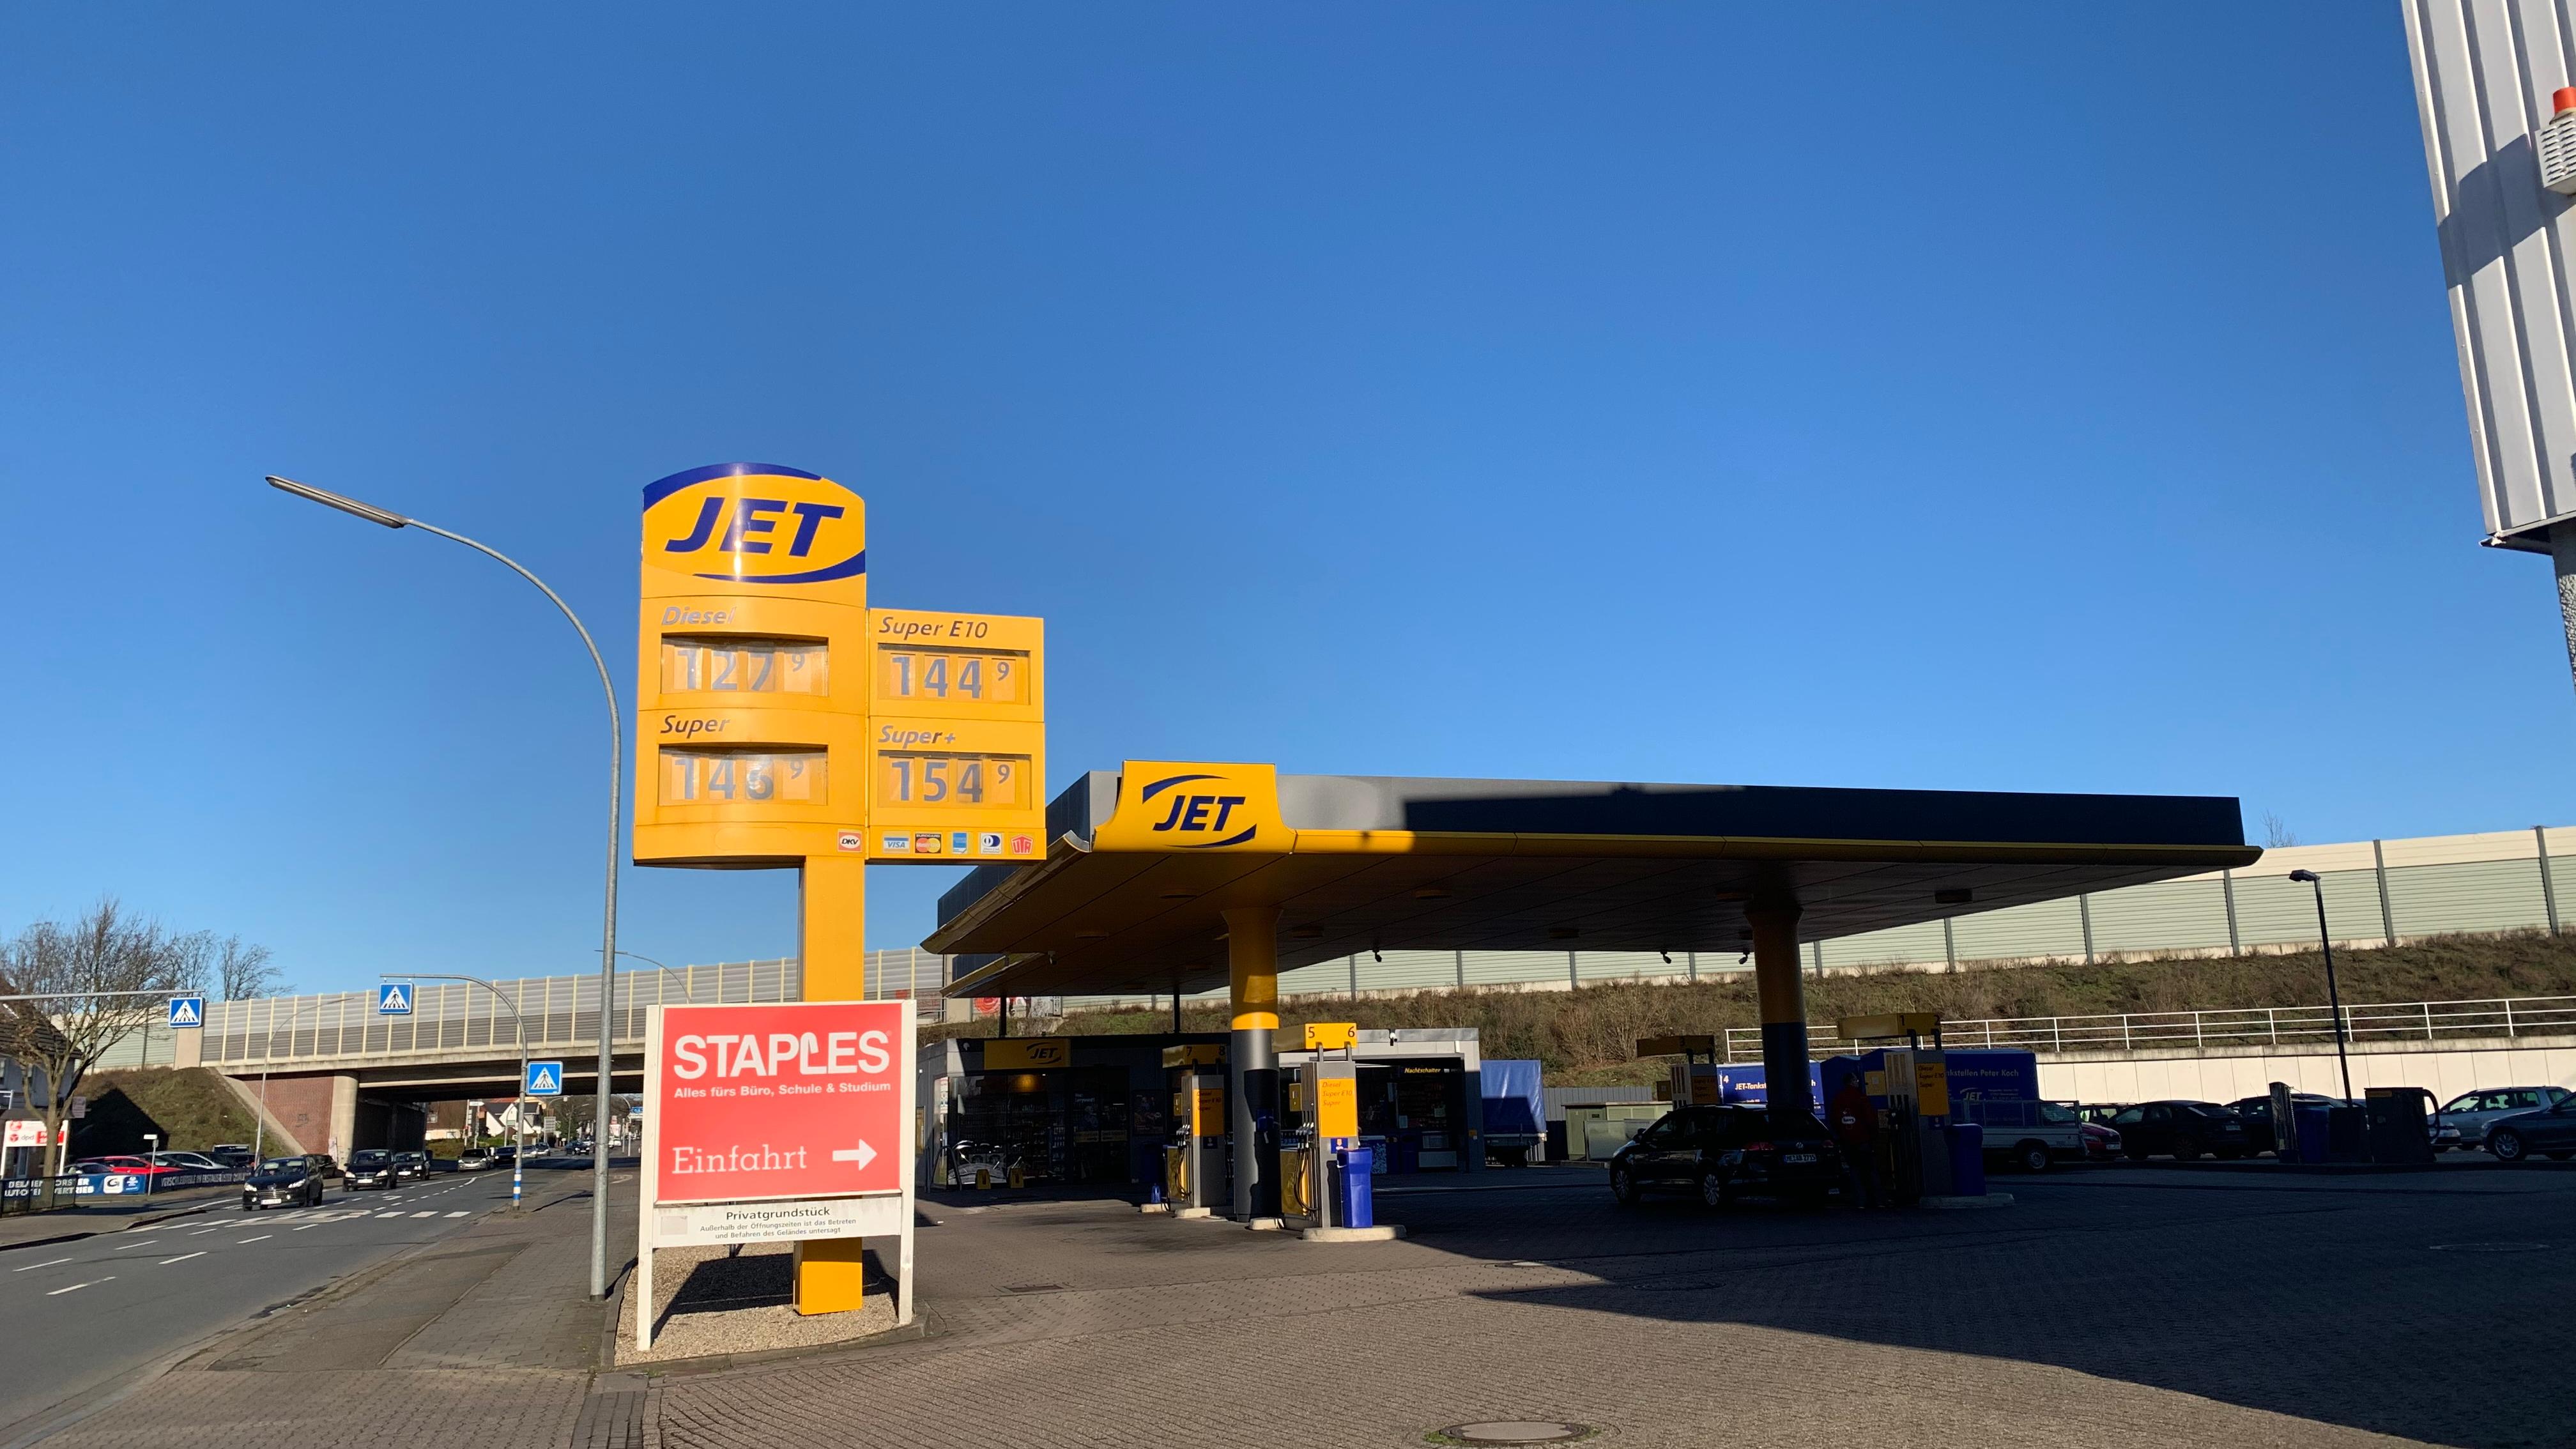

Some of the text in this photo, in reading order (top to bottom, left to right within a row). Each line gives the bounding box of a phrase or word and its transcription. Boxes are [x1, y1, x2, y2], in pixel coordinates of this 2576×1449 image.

[664, 497, 845, 557] JET
[661, 606, 737, 626] Diesel
[878, 617, 988, 640] Super E10
[660, 715, 730, 739] Super
[1152, 795, 1246, 831] JET
[1900, 1015, 1905, 1025] 1
[1308, 1026, 1315, 1038] 5
[1347, 1026, 1354, 1038] 6
[673, 1031, 890, 1080] STAPLES
[1030, 1047, 1058, 1059] JET
[1186, 1046, 1192, 1056] 7
[1218, 1046, 1225, 1056] 8
[674, 1082, 891, 1098] Alles fürs Büro, Schule & Studium
[1962, 1092, 1982, 1101] JET
[671, 1144, 807, 1174] Einfahrt
[726, 1206, 831, 1221] Privatgrundstück
[700, 1222, 735, 1232] Außerhalb
[751, 1220, 802, 1230] Öffnungszeiten
[809, 1227, 841, 1236] untersagt
